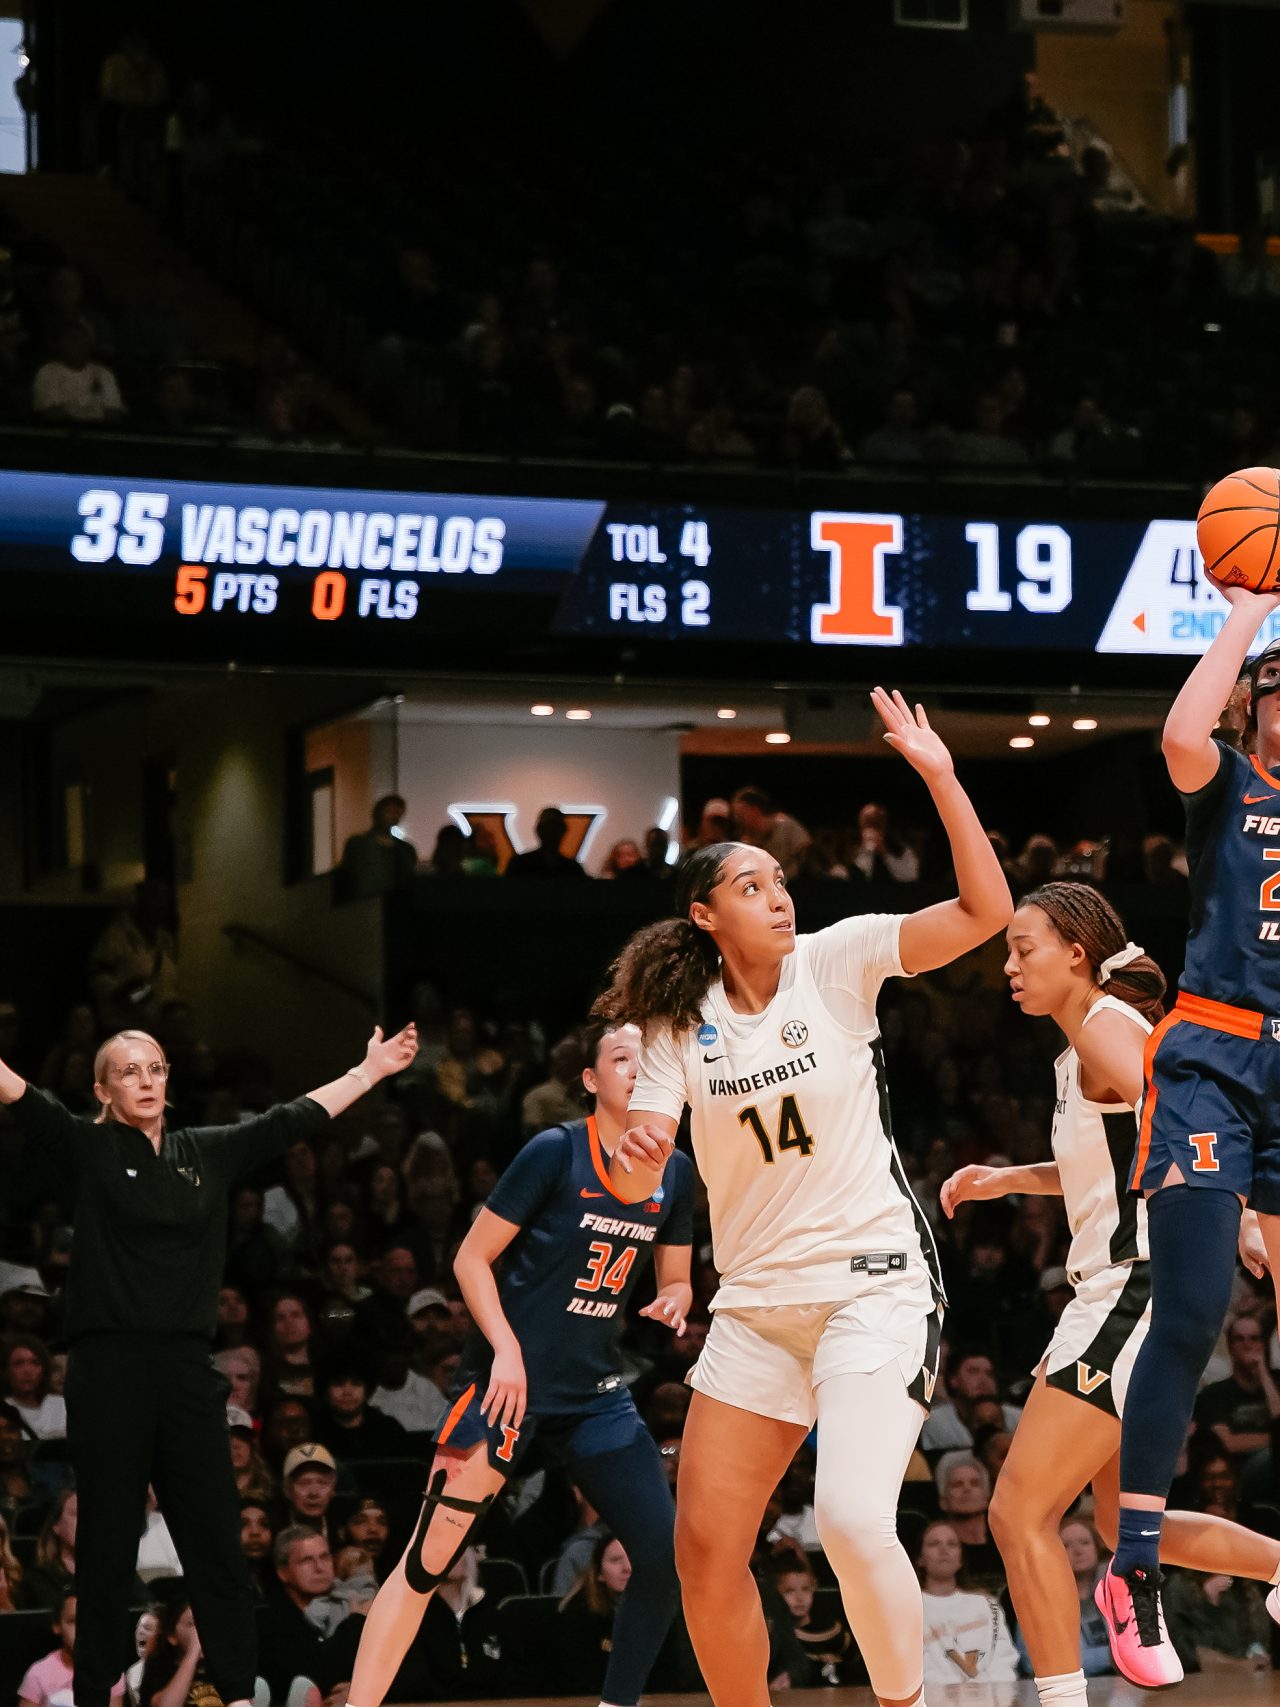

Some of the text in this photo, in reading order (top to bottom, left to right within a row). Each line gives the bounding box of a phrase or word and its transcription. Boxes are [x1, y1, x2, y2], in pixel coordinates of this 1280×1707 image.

[71, 490, 506, 574] 35 VASCONCELOS
[607, 521, 710, 567] TOL 4
[175, 566, 418, 620] 5 PTS 0 FLS
[811, 511, 903, 645] I
[965, 523, 1072, 613] 19
[609, 581, 710, 626] FLS 2
[709, 1052, 818, 1096] VANDERBILT
[736, 1093, 815, 1164] 14
[579, 1213, 657, 1242] FIGHTING
[574, 1241, 638, 1295] 34
[566, 1297, 618, 1318] ILLINI
[1076, 1360, 1111, 1395] V
